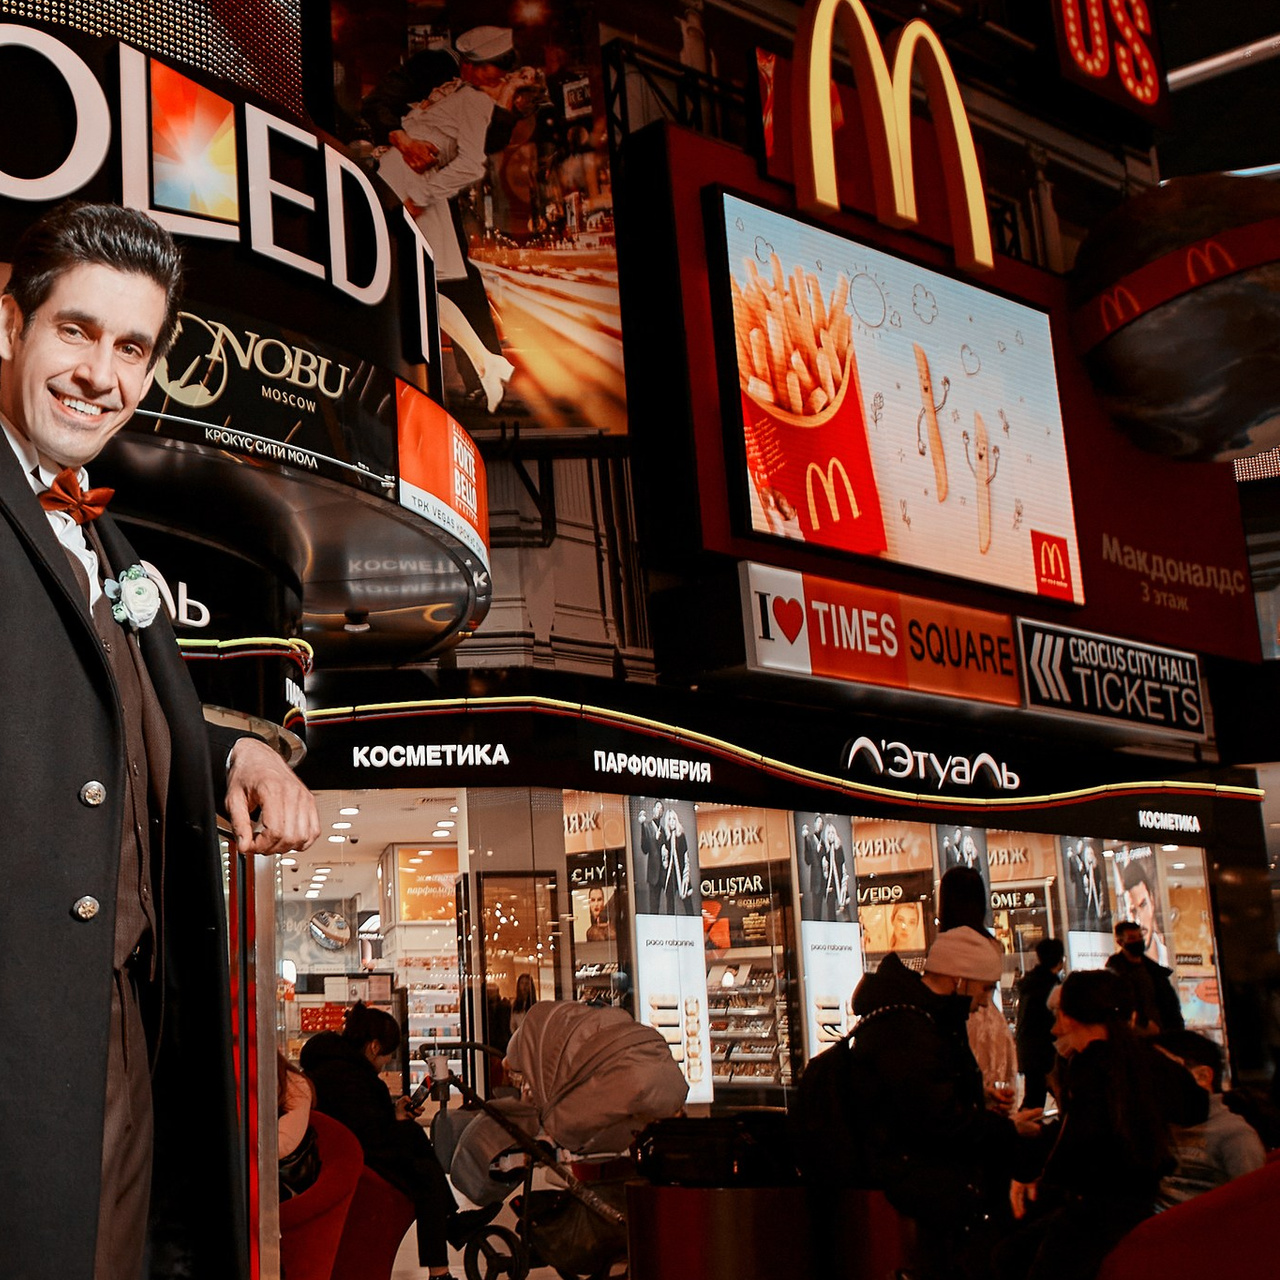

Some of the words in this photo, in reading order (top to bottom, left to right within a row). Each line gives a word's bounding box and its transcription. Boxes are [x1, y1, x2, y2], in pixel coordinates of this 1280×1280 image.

[205, 319, 351, 400] NOBU
[261, 384, 317, 414] MOSCOW
[205, 427, 253, 449] КРОКУС
[255, 440, 286, 460] СИТИ
[287, 447, 319, 470] МОЛЛ
[1101, 531, 1247, 596] Макдоналдс
[1141, 581, 1151, 604] 3
[1153, 588, 1189, 613] этаж
[754, 589, 776, 643] I
[811, 599, 899, 659] TIMES
[907, 617, 1015, 677] SQUARE
[1068, 636, 1125, 670] CROCUS
[1126, 647, 1157, 679] CITY
[1158, 655, 1197, 688] HALL
[1071, 664, 1202, 727] TICKETS
[352, 743, 510, 768] КОСМЕТИКА
[593, 749, 712, 783] ПАРФЮМЕРИЯ
[1138, 809, 1202, 833] КОСМЕТИКА
[646, 939, 664, 947] paco
[664, 938, 695, 947] rabanne
